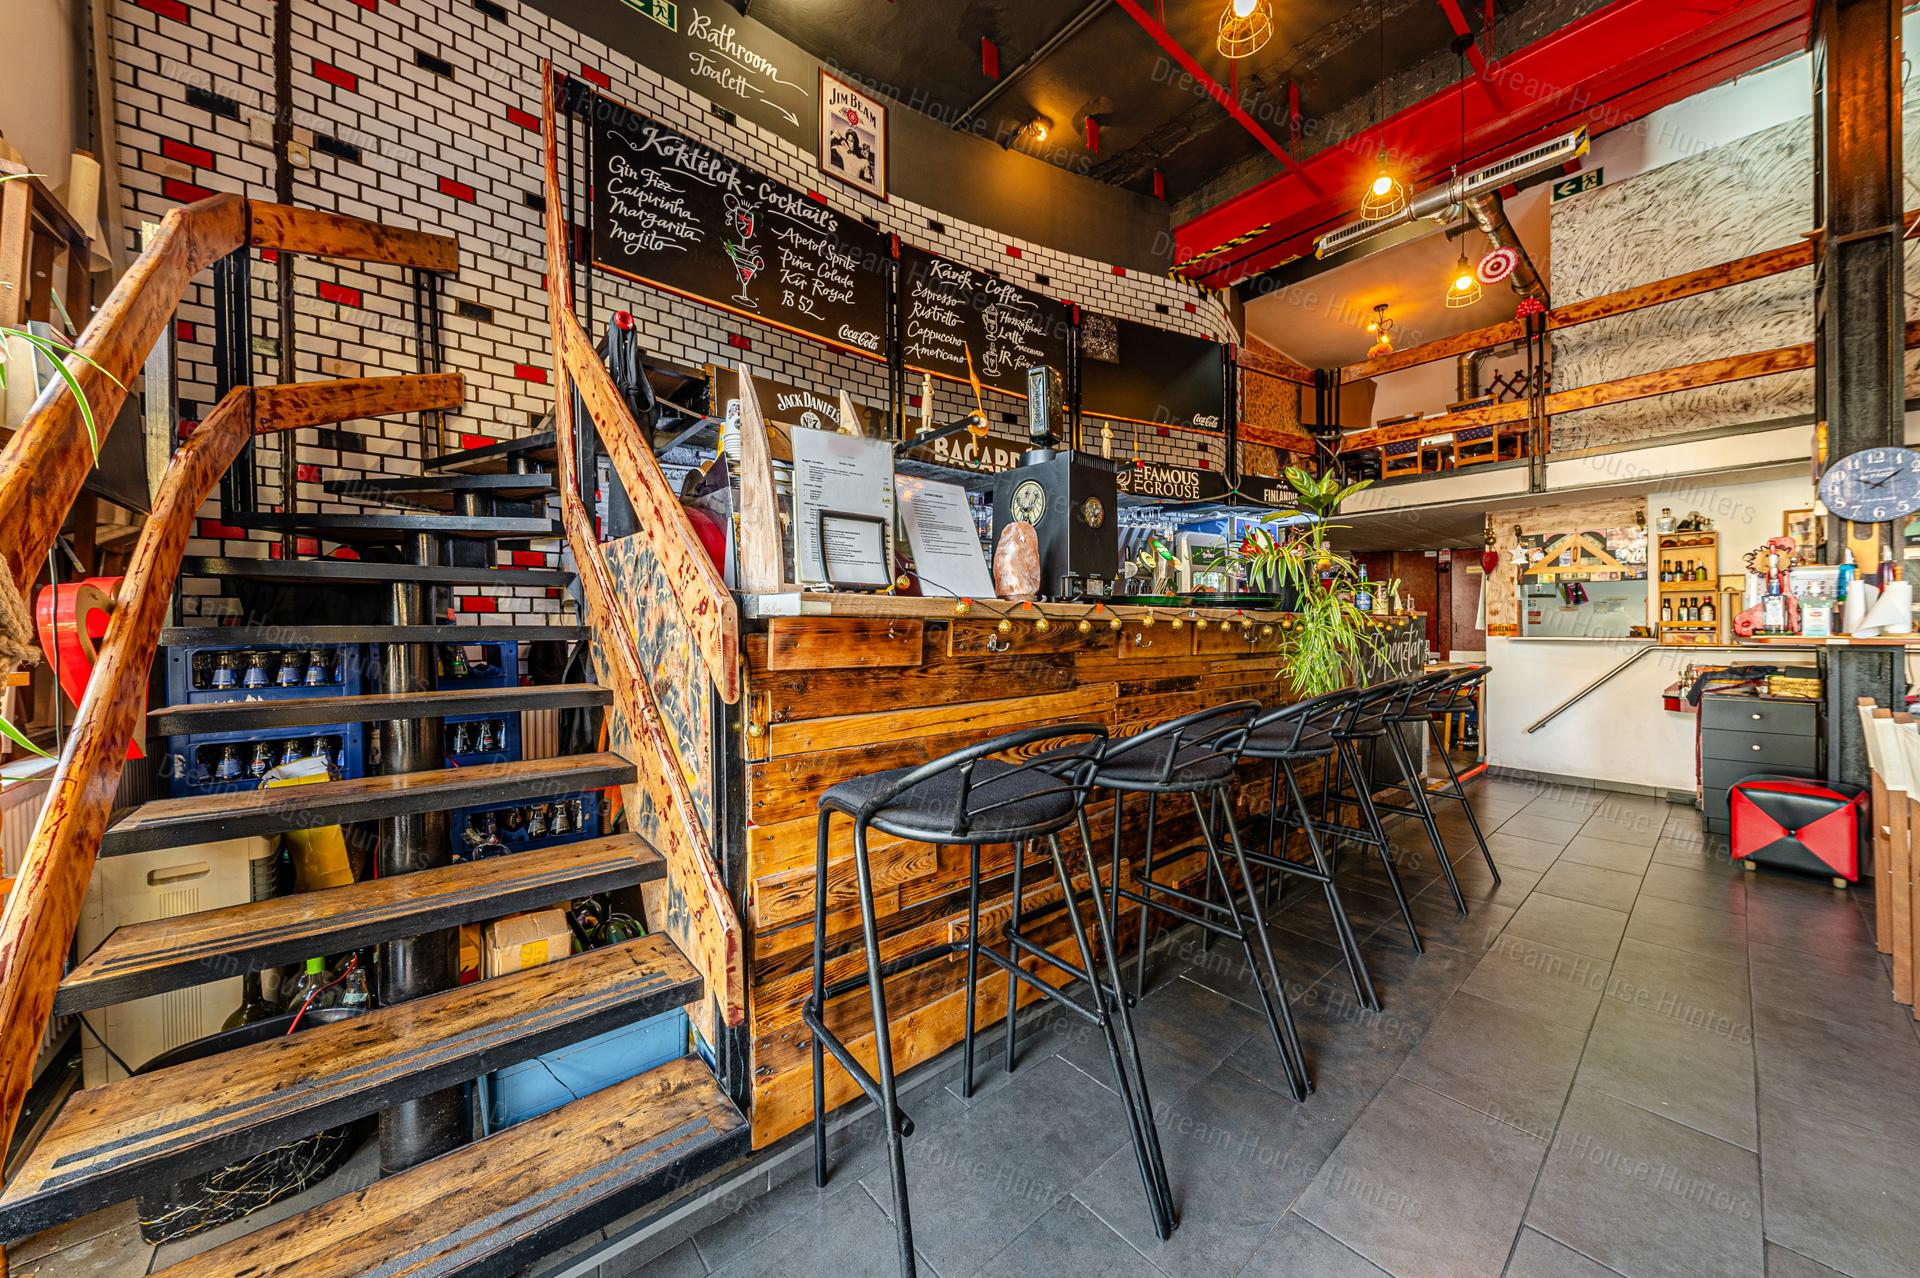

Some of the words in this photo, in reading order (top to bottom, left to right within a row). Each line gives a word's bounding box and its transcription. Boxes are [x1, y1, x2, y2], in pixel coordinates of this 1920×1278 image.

[688, 8, 798, 91] Bathroom
[689, 52, 764, 99] Toalett
[829, 87, 848, 106] JIM
[850, 93, 877, 128] BEAM
[608, 155, 639, 181] Gin
[641, 168, 686, 194] Fizz
[636, 127, 744, 196] Koktélok
[758, 182, 839, 232] Cocktail's
[608, 178, 700, 222] Caipirinha
[610, 196, 705, 243] Margarita
[771, 227, 827, 257] Aperol
[826, 244, 860, 272] Spritz
[780, 269, 807, 290] Kir
[812, 278, 855, 304] Royal
[817, 262, 855, 288] Colada
[781, 290, 795, 307] B
[798, 295, 825, 320] 52
[911, 280, 965, 306] Espresso
[985, 279, 1034, 305] Coffee
[908, 300, 965, 327] Ristretto
[907, 321, 966, 347] Cappuccino
[997, 326, 1025, 345] Latte
[903, 342, 967, 364] Americano
[776, 393, 804, 411] JACK
[1846, 459, 1860, 471] 11
[1867, 451, 1885, 464] 12
[1896, 452, 1903, 464] 1
[1144, 466, 1199, 486] FAMOUS
[1830, 470, 1846, 481] 10
[1143, 480, 1200, 499] GROUSE
[1828, 485, 1839, 497] 9
[1834, 497, 1846, 509] 8
[1850, 505, 1863, 517] 7
[1872, 506, 1886, 518] 6
[1896, 500, 1910, 513] 5
